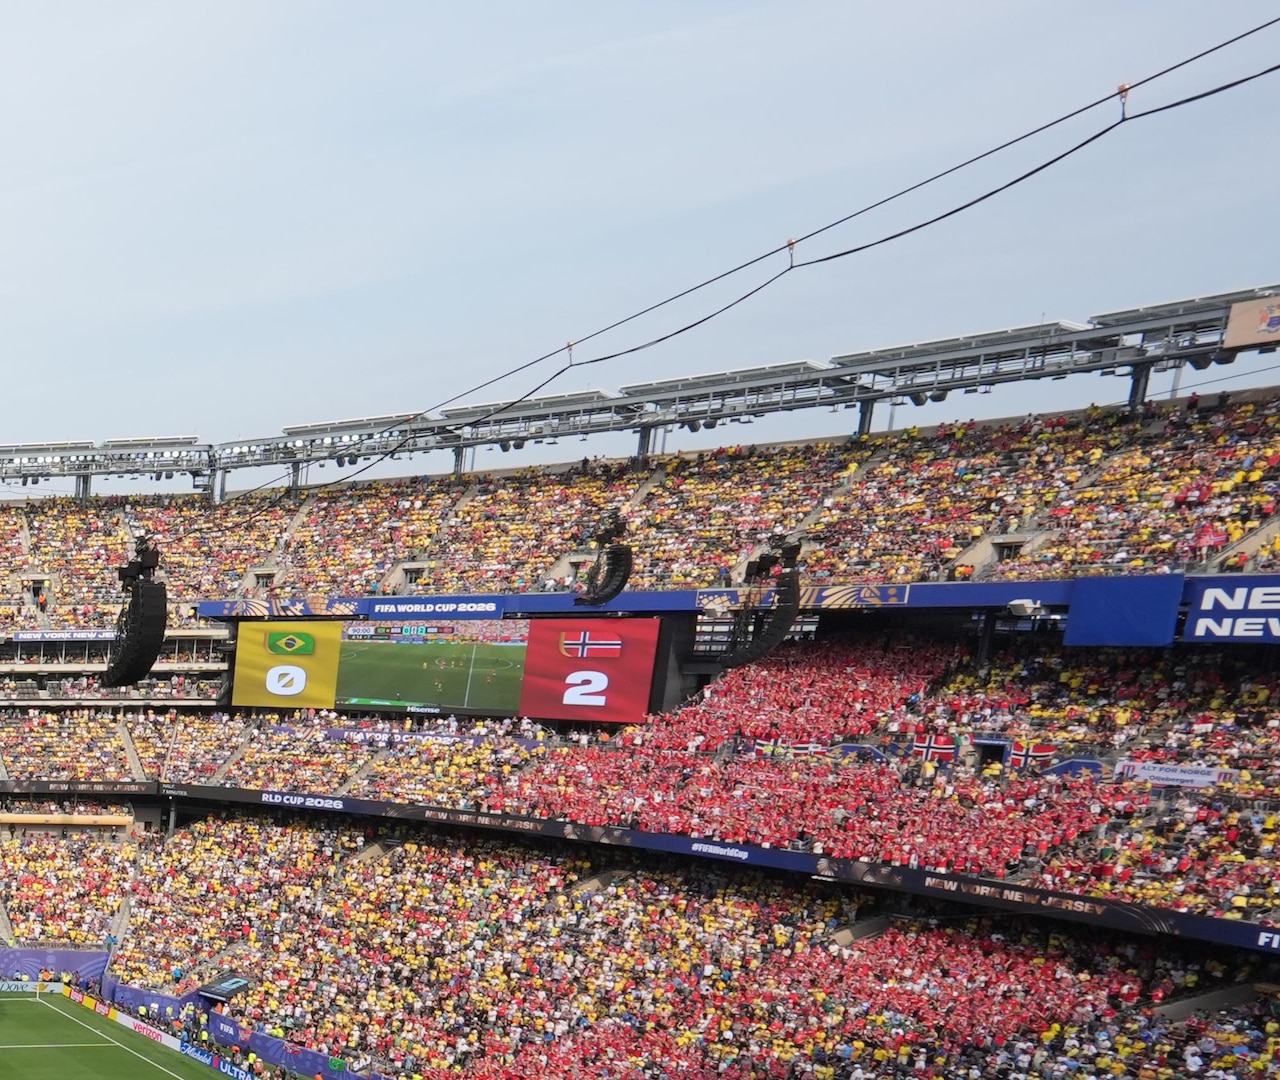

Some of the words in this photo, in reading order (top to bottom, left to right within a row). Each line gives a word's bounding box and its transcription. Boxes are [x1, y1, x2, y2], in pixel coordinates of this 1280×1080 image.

[374, 604, 397, 613] FIFA
[397, 603, 435, 612] WORLD
[435, 603, 457, 612] CUP
[457, 602, 496, 612] 2026
[562, 670, 609, 706] 2
[406, 705, 441, 714] Hisense
[1159, 766, 1178, 774] FOR
[1179, 767, 1213, 777] NORGE
[261, 793, 282, 803] RLD
[283, 795, 304, 806] CUP
[304, 798, 343, 809] 2026
[691, 842, 749, 860] #FIFAWorldCup
[925, 876, 958, 891] NEW
[961, 882, 1001, 899] YORK
[1002, 889, 1040, 905] NEW
[1041, 896, 1108, 915] JERSEY
[0, 982, 28, 992] Dove
[132, 1021, 163, 1043] verizon
[220, 1023, 234, 1036] FIFA
